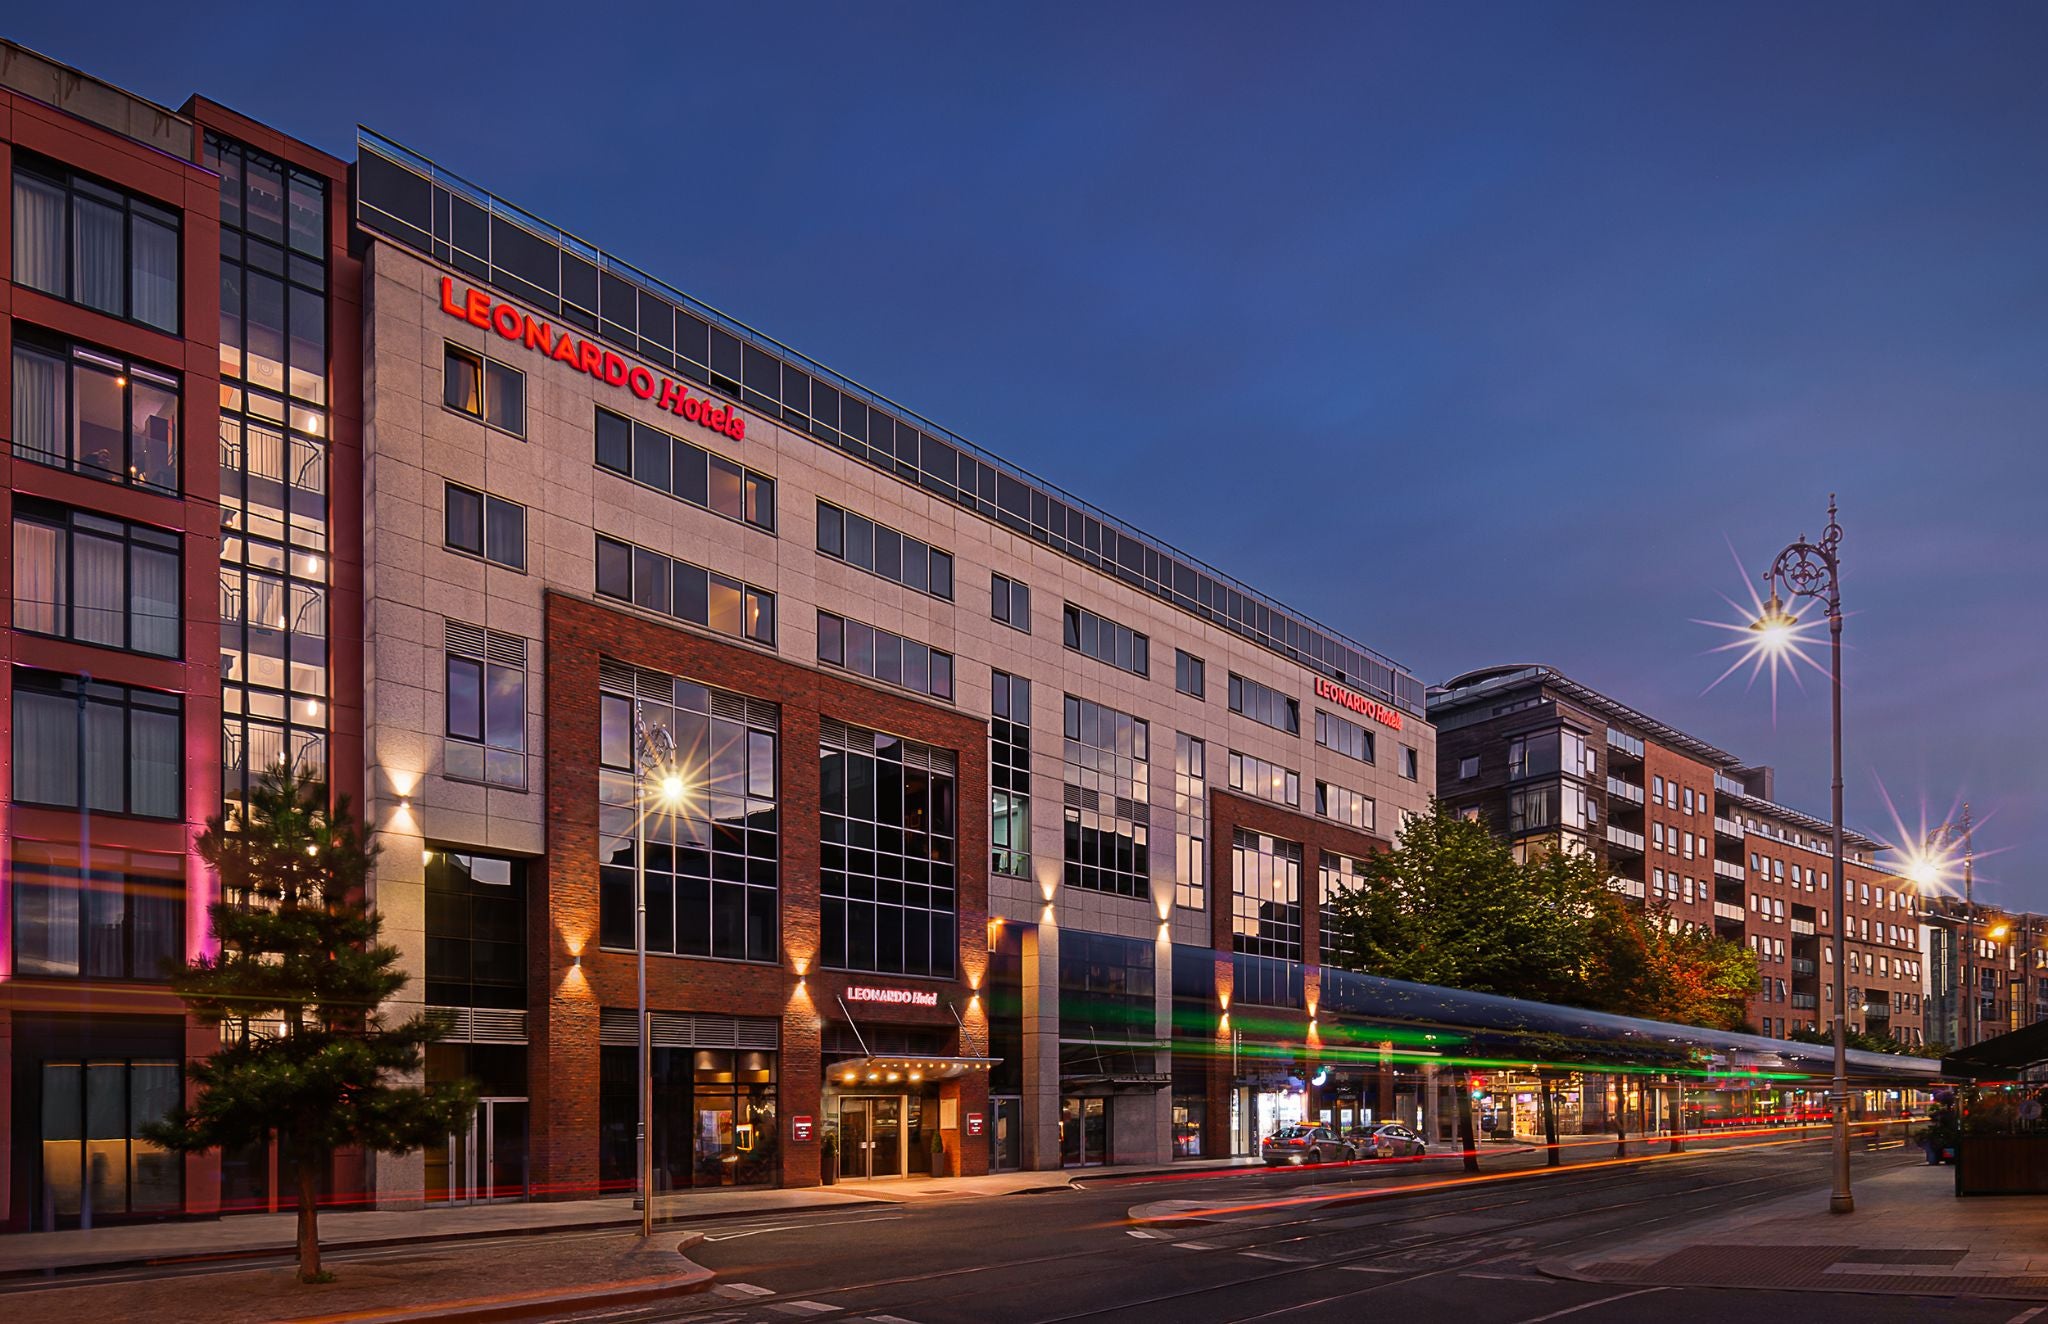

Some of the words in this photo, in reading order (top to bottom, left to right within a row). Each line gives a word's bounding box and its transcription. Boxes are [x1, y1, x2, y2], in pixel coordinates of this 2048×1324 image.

[441, 275, 656, 400] LEONARDO
[658, 376, 747, 441] Hotels
[1315, 676, 1376, 718] LEONARDO
[846, 986, 912, 1003] LEONARDO
[911, 991, 938, 1006] Hotel
